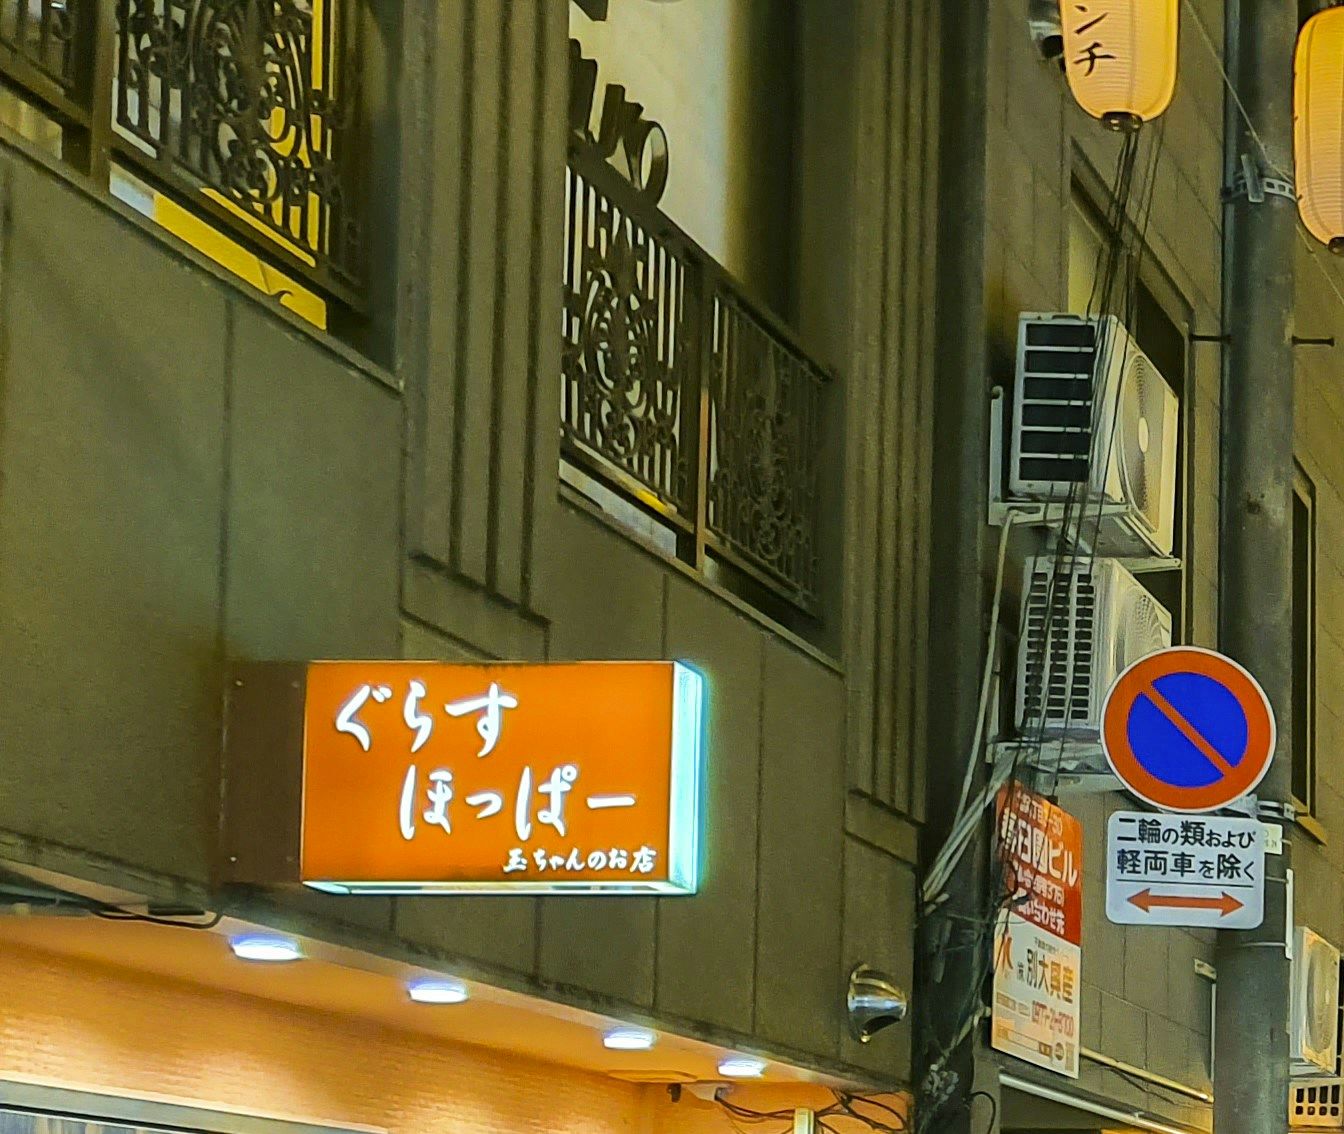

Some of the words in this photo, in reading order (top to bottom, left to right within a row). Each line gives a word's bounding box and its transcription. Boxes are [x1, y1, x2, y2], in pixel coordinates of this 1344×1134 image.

[336, 680, 519, 758] ぐらす
[399, 764, 636, 841] ほっぱー
[1117, 817, 1256, 850] 二輪の類および
[503, 846, 656, 874] 玉ちゃんのお店
[1117, 849, 1255, 881] 軽両車を除く
